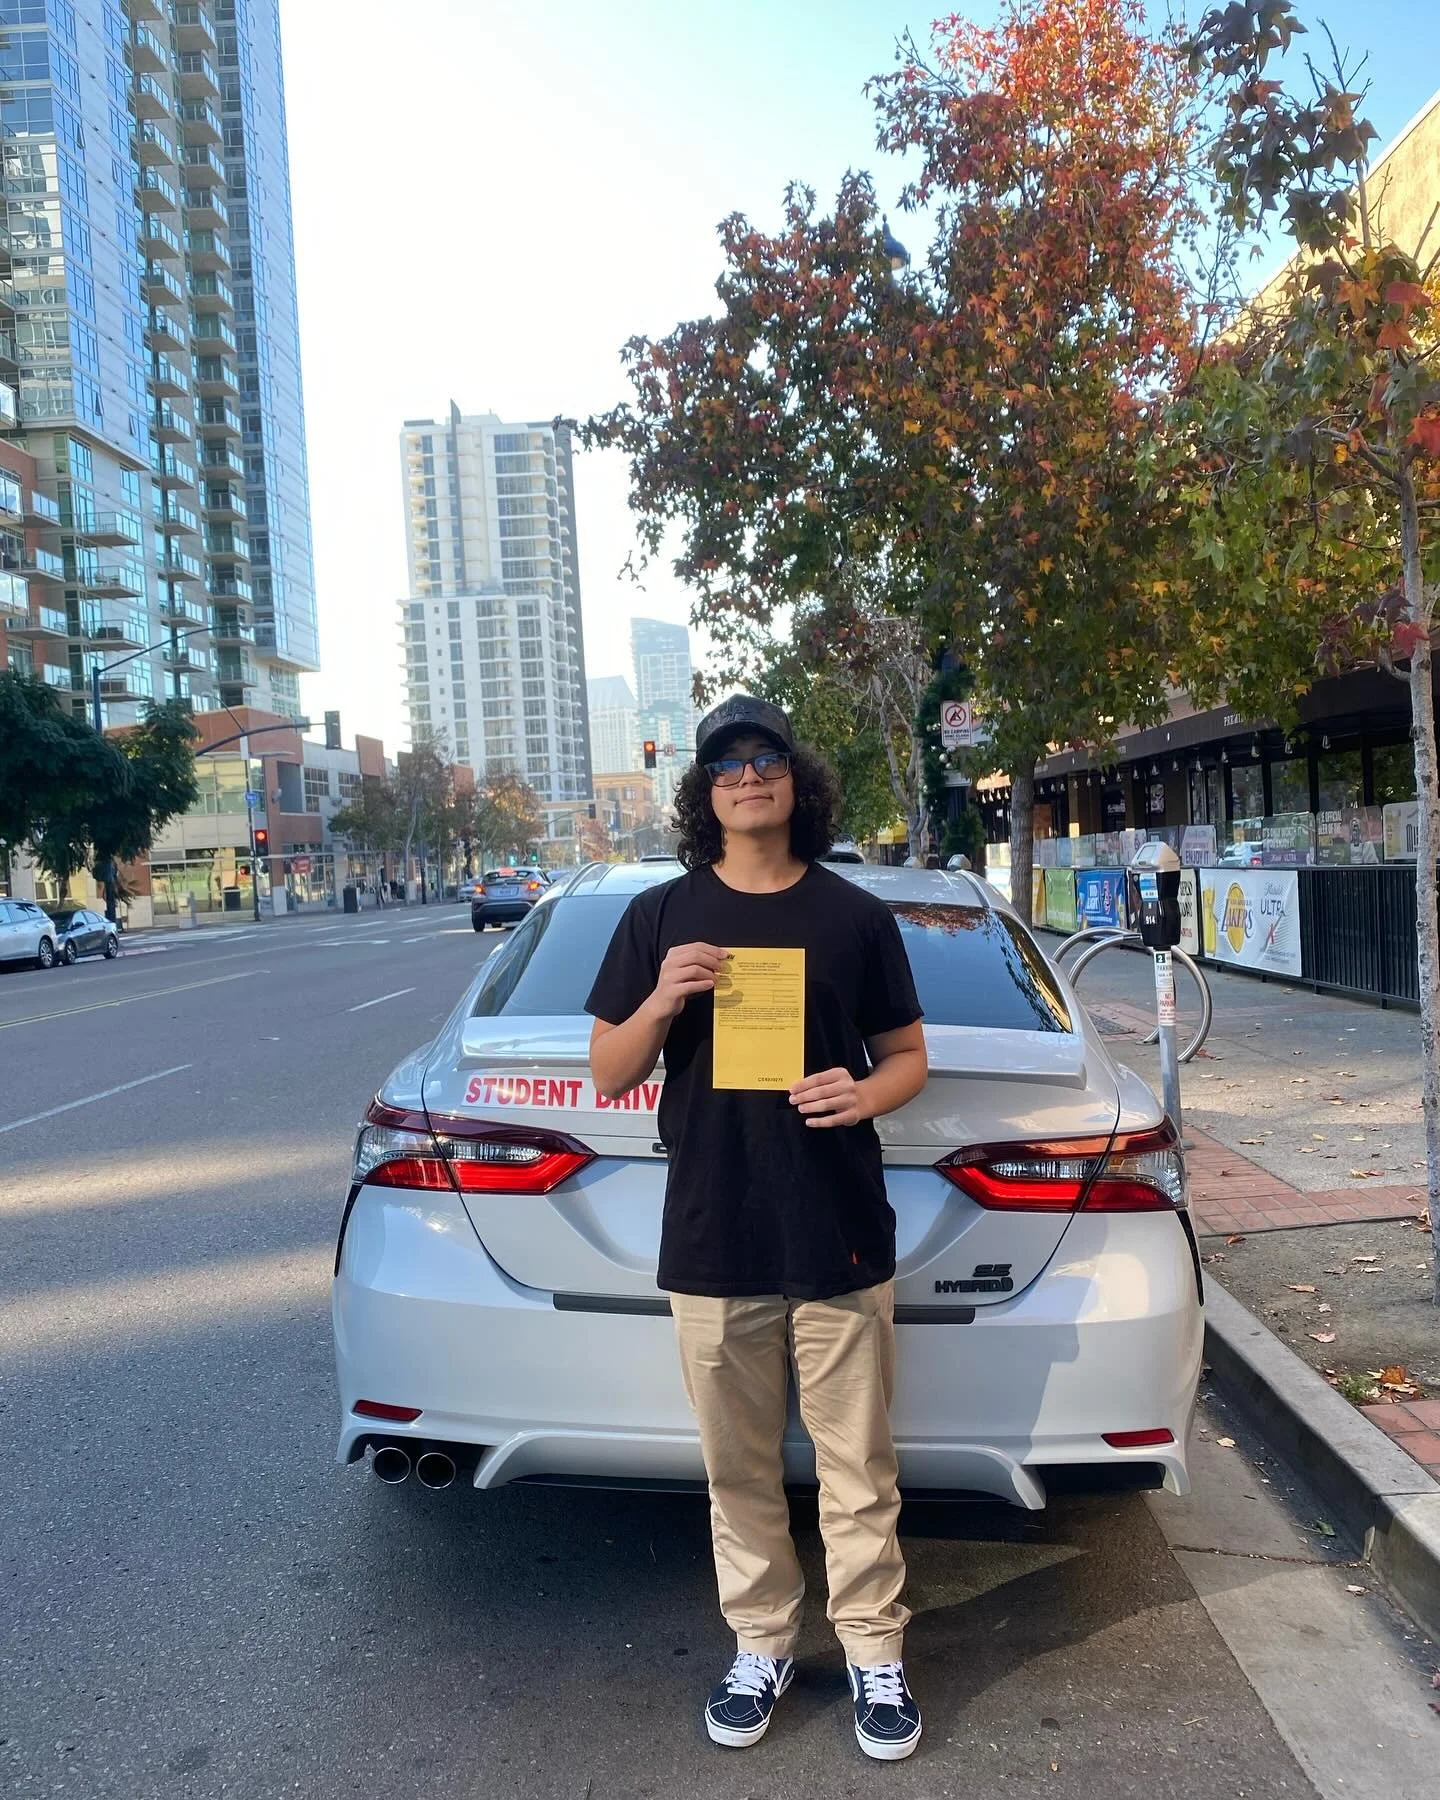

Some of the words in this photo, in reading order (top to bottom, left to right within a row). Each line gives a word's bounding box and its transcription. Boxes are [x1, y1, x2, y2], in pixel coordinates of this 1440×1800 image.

[1185, 850, 1203, 865] ENJOY
[1260, 898, 1286, 917] ULTRA
[465, 1077, 583, 1108] STUDENT
[972, 1263, 1012, 1277] SE
[935, 1279, 1002, 1293] HYBRID
